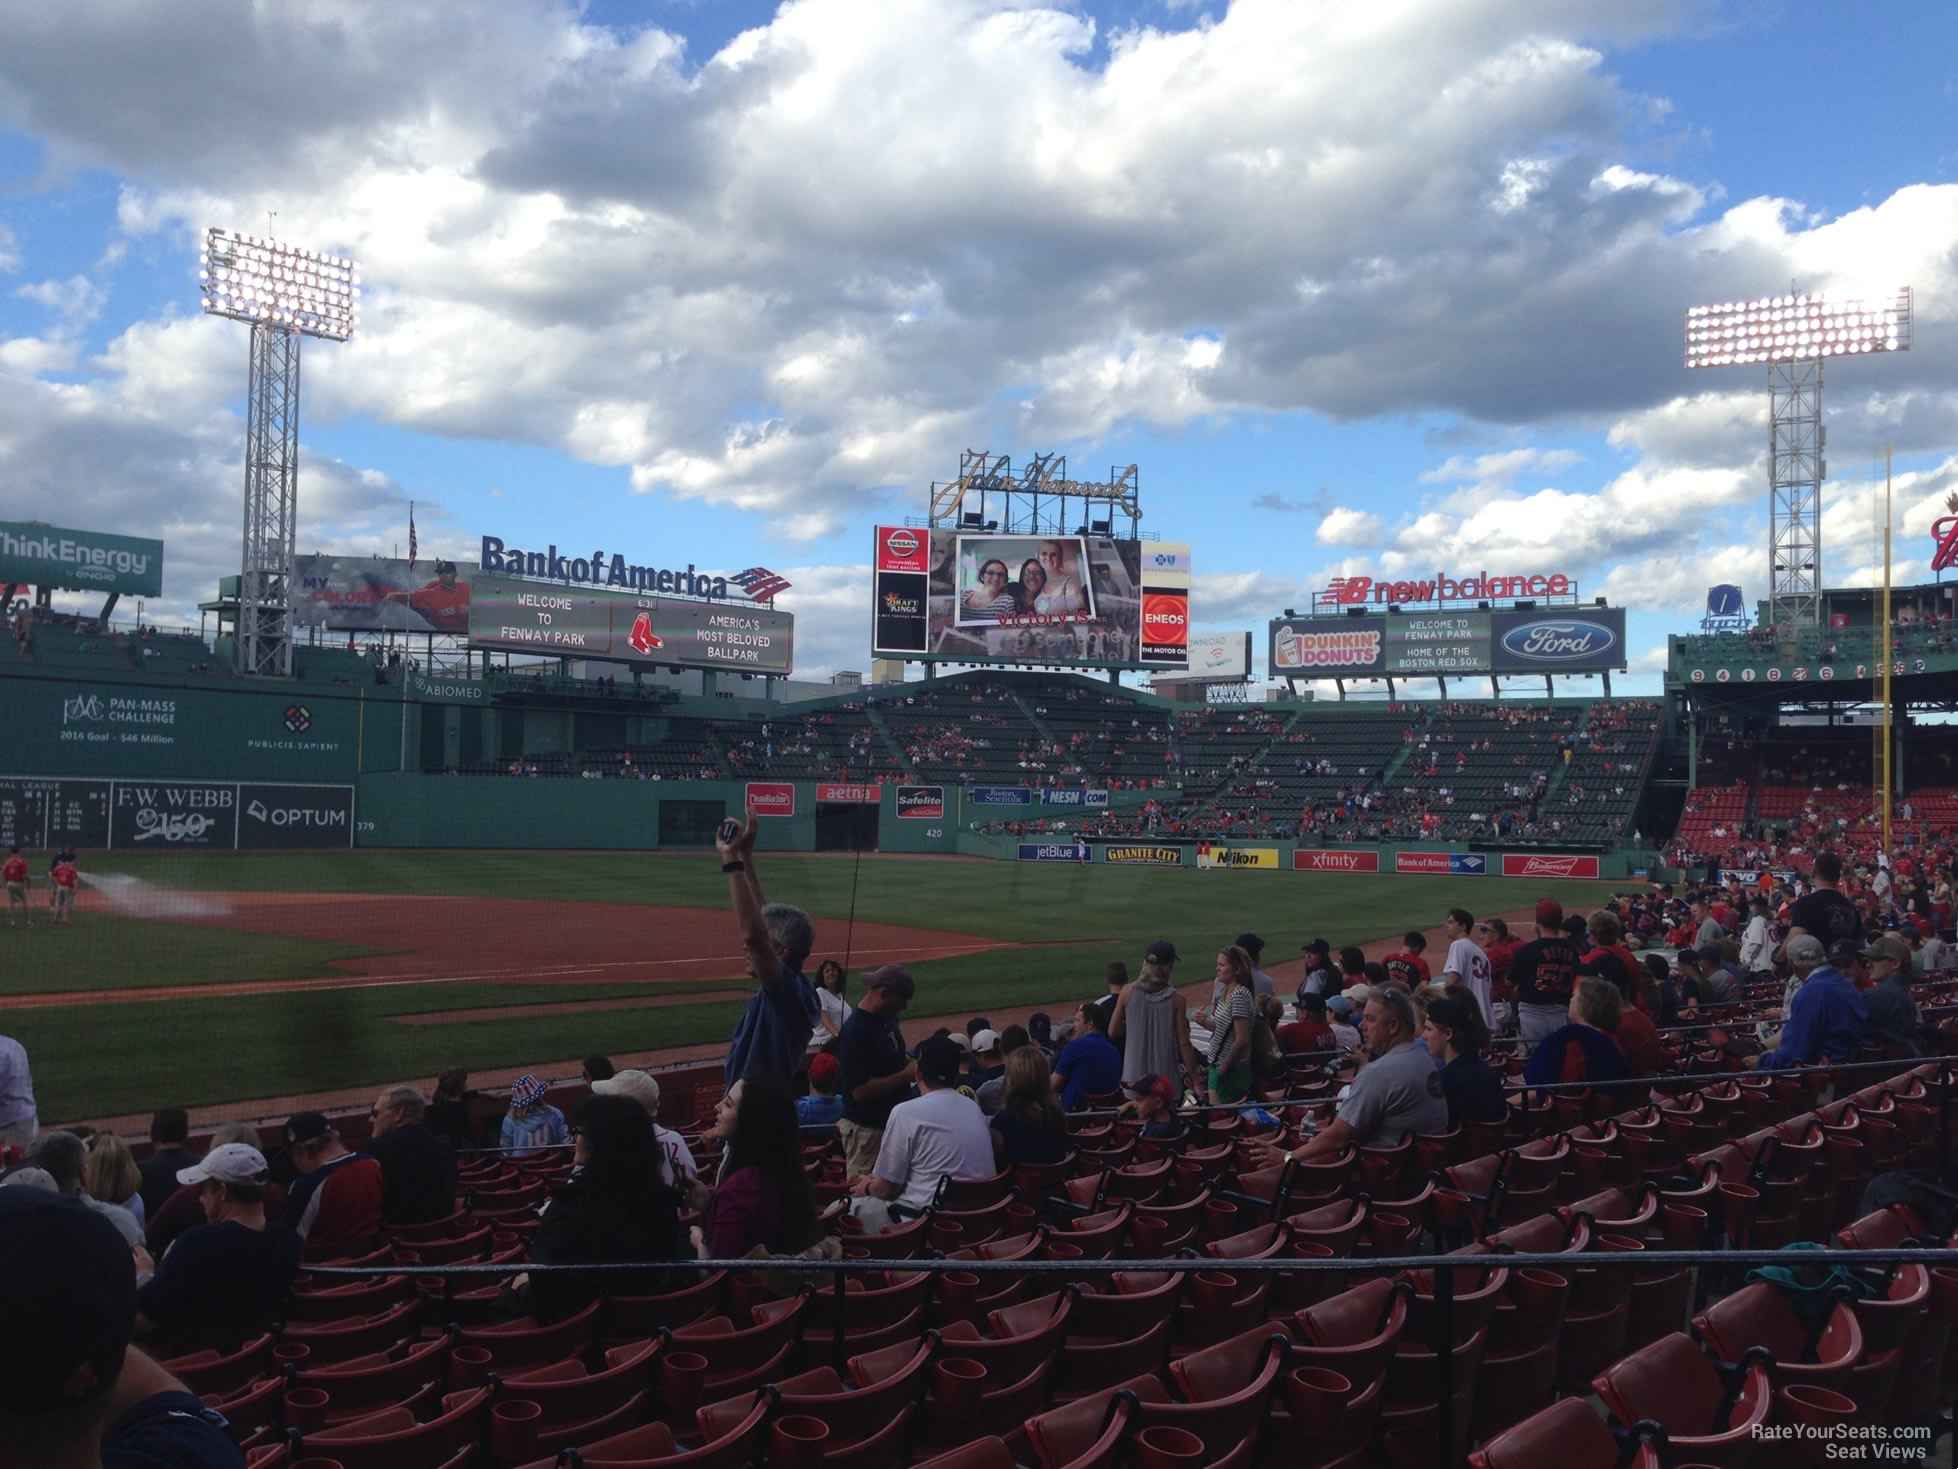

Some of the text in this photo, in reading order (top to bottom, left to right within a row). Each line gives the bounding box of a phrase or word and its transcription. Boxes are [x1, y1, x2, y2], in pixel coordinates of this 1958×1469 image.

[930, 449, 1143, 520] John Hancock
[481, 535, 727, 600] Bank of America
[303, 577, 328, 588] MY
[1374, 580, 1436, 603] new
[1438, 571, 1568, 600] balance
[518, 593, 572, 610] WELCOME
[538, 613, 551, 625] TO
[709, 615, 760, 631] AMERICA'S
[997, 610, 1068, 628] Victory
[1145, 613, 1184, 625] ENEOS
[1409, 619, 1468, 629] WELCOME TO
[501, 626, 585, 646] FENWAY PARK
[697, 629, 770, 647] MOST BELOVED
[1304, 633, 1378, 649] DUNKIN'
[1405, 629, 1472, 640] FENWAY PARK
[1523, 626, 1592, 653] Ford
[1189, 637, 1226, 647] OWNLOAD
[708, 646, 759, 662] BALLPARK
[1304, 649, 1374, 664] DONUTS
[1407, 647, 1470, 657] HOME OF THE
[1399, 658, 1478, 668] BOSTON RED SOX
[425, 685, 482, 698] ABIOMED
[110, 698, 176, 712] PAN-MASS
[108, 711, 175, 724] CHALLENGE
[60, 731, 84, 740] 2016
[87, 732, 109, 741] Goal
[141, 735, 174, 744] Million
[117, 788, 234, 808] F.W. WEBB
[826, 786, 871, 800] aetna
[1049, 791, 1079, 804] NESN
[898, 796, 941, 806] Safelite
[271, 809, 345, 826] OPTUM
[911, 808, 941, 816] AutoGlass
[357, 822, 375, 831] 379
[926, 829, 943, 838] 420
[1036, 845, 1073, 859] jetBlue
[1107, 847, 1180, 862] GRANITE CITY
[1216, 852, 1259, 865] Nikon
[1312, 853, 1358, 869] xfinity
[1398, 857, 1418, 867] Bank
[1428, 859, 1460, 868] America
[1528, 861, 1573, 871] Budweiser
